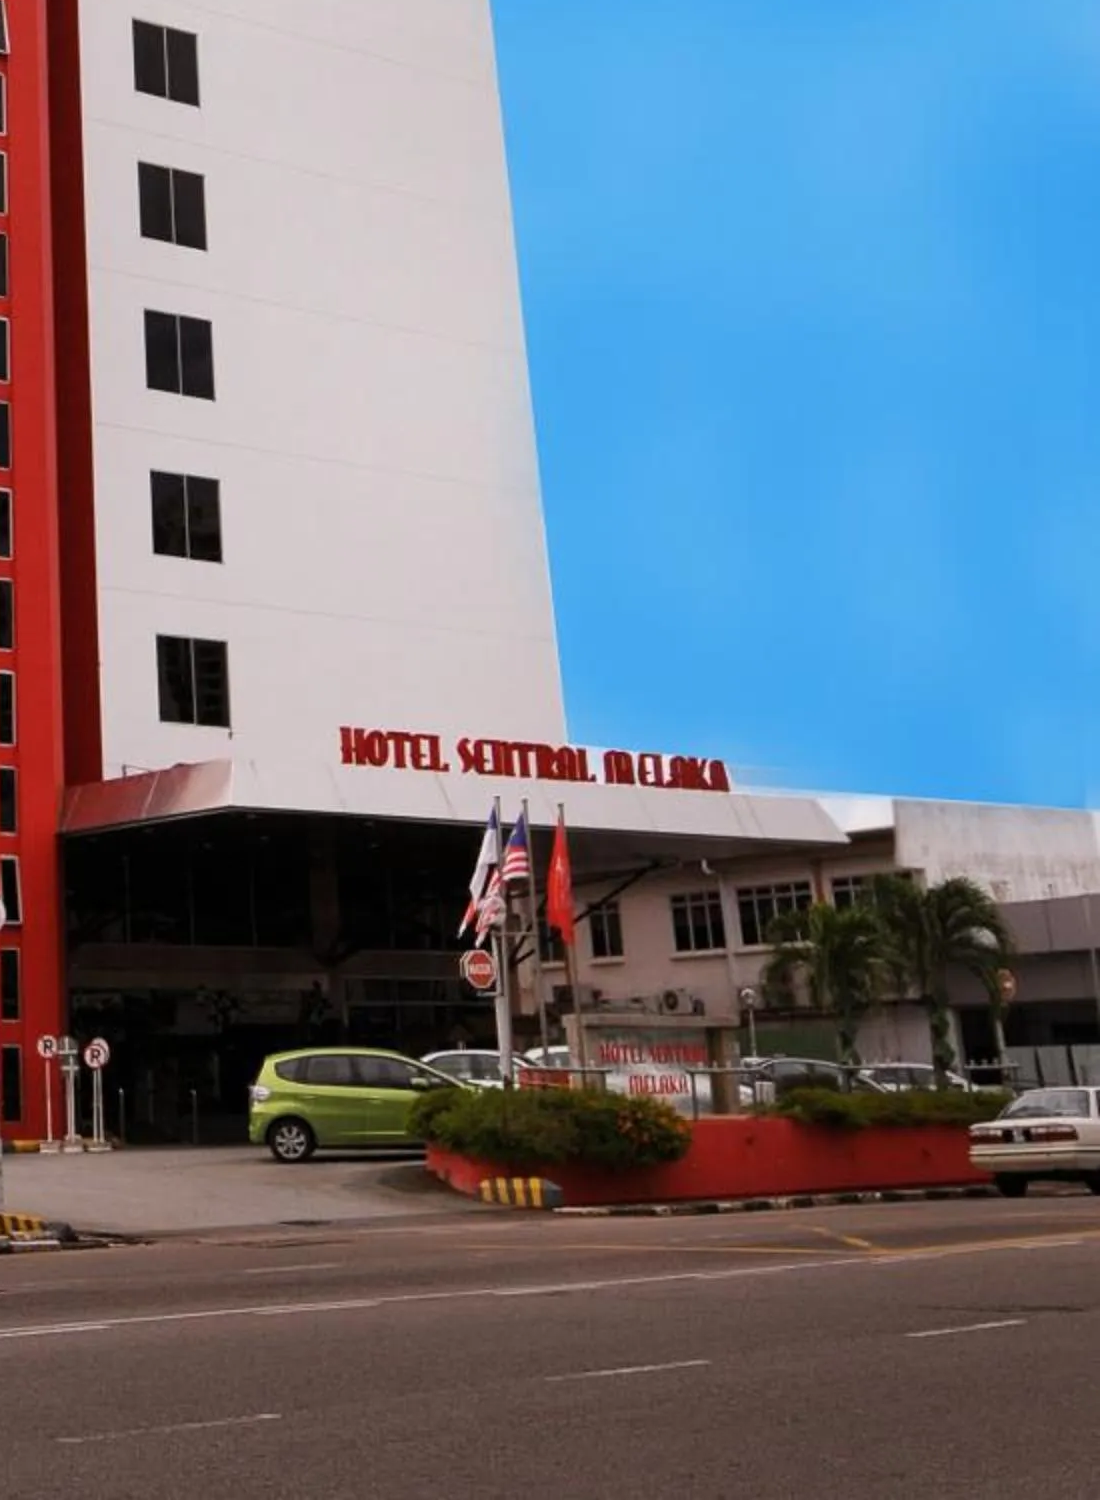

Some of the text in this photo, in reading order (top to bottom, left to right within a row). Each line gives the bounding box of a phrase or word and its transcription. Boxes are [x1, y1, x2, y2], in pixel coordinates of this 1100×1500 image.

[340, 727, 730, 792] HOTEL SENTRAL MELAKA
[629, 1074, 689, 1095] MELAKA
